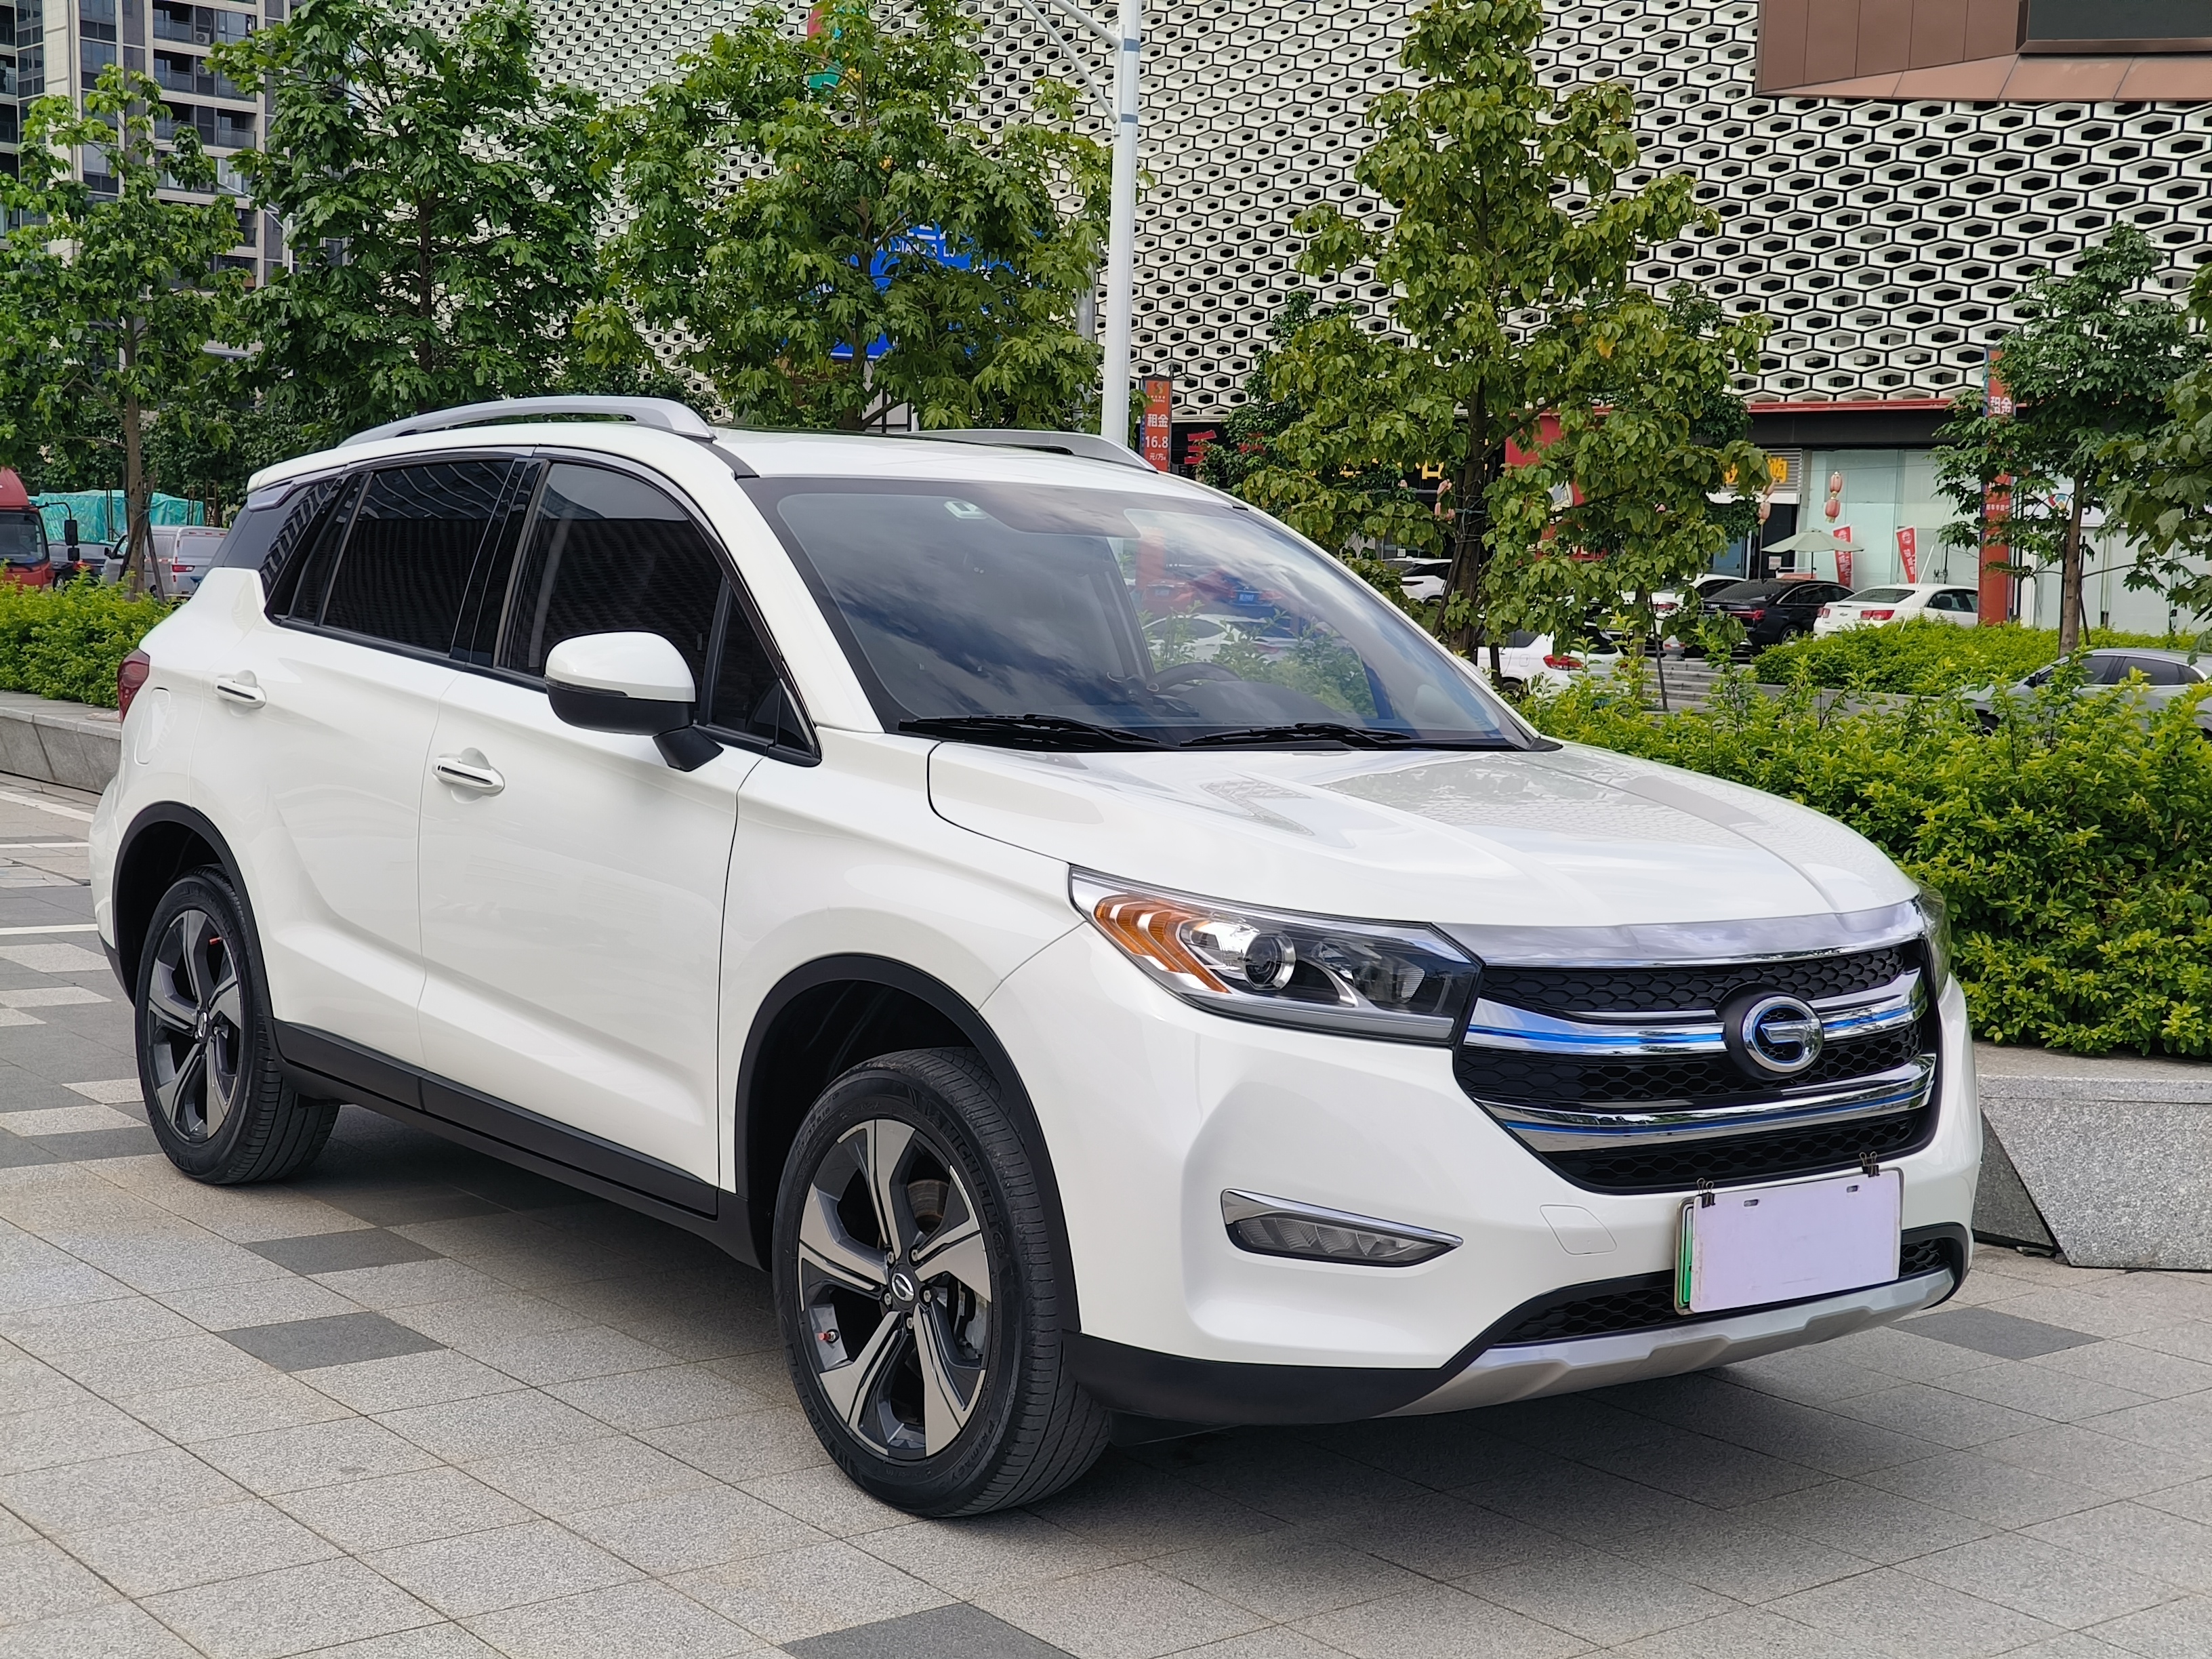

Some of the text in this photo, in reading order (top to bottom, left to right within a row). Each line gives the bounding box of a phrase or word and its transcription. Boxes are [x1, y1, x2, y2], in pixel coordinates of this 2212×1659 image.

[1147, 413, 1169, 428] 租金
[1145, 436, 1168, 448] 16.8
[941, 1120, 999, 1227] MICHELIN
[951, 1420, 995, 1482] PRIMACY
